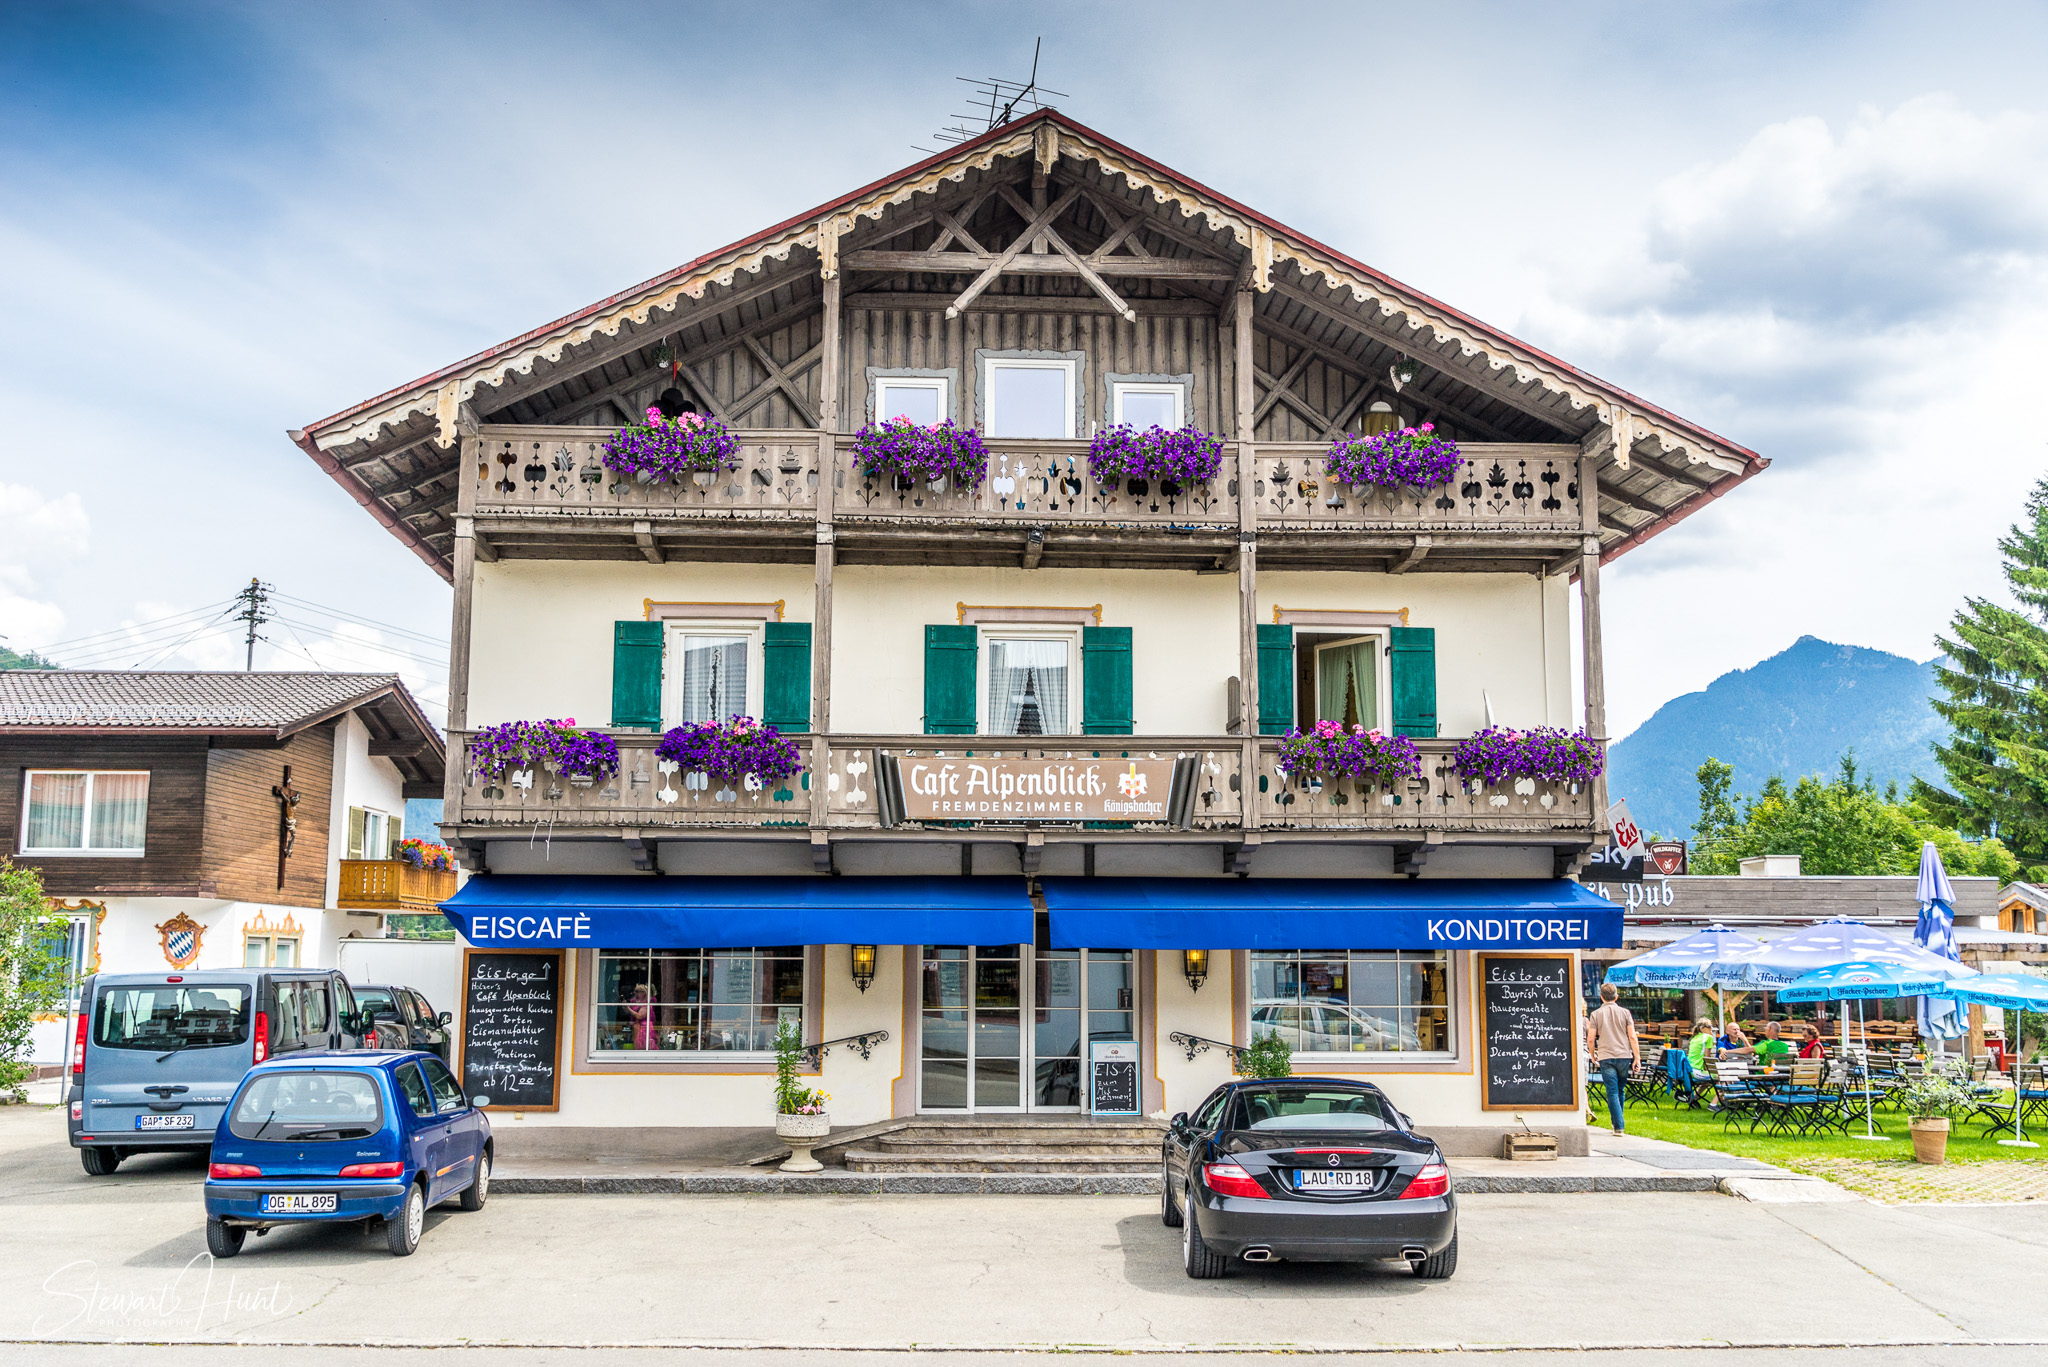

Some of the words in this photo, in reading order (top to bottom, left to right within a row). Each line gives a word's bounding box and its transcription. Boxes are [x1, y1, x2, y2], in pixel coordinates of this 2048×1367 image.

[911, 763, 960, 798] Cafe
[966, 763, 1106, 800] Alpenblick
[932, 801, 1084, 812] FREMDENZIMMER
[1104, 799, 1162, 815] Königsbacher
[1615, 817, 1638, 850] Eis
[1622, 880, 1674, 913] Pub
[472, 912, 591, 939] EISCAFÈ
[1428, 919, 1589, 940] KONDITOREI
[476, 964, 501, 978] Eis
[506, 968, 518, 979] to
[521, 972, 537, 985] go
[1492, 967, 1516, 981] Eis
[1520, 968, 1532, 981] to
[1536, 975, 1551, 988] go
[503, 989, 551, 1002] Alpenblick
[1501, 985, 1538, 1003] Bayrish
[1543, 986, 1564, 999] Pub
[1837, 987, 1889, 996] Hacker-Pschorr
[528, 1003, 553, 1014] Kuchen
[480, 1016, 494, 1024] und
[503, 1014, 532, 1024] Torten
[1520, 1014, 1545, 1024] Pizza
[472, 1024, 545, 1037] Eismanufaktur
[1494, 1030, 1522, 1044] frische
[1526, 1031, 1554, 1040] Salate
[1095, 1063, 1119, 1076] EIS
[1511, 1061, 1522, 1070] ab
[483, 1075, 496, 1087] ab
[142, 1117, 158, 1126] GAP
[164, 1116, 175, 1125] SF
[176, 1115, 192, 1126] 232
[1302, 1172, 1327, 1185] LAU
[1336, 1172, 1352, 1185] RD
[1355, 1172, 1371, 1185] 18
[269, 1196, 285, 1208] OG
[293, 1196, 308, 1208] AL
[311, 1196, 335, 1208] 895
